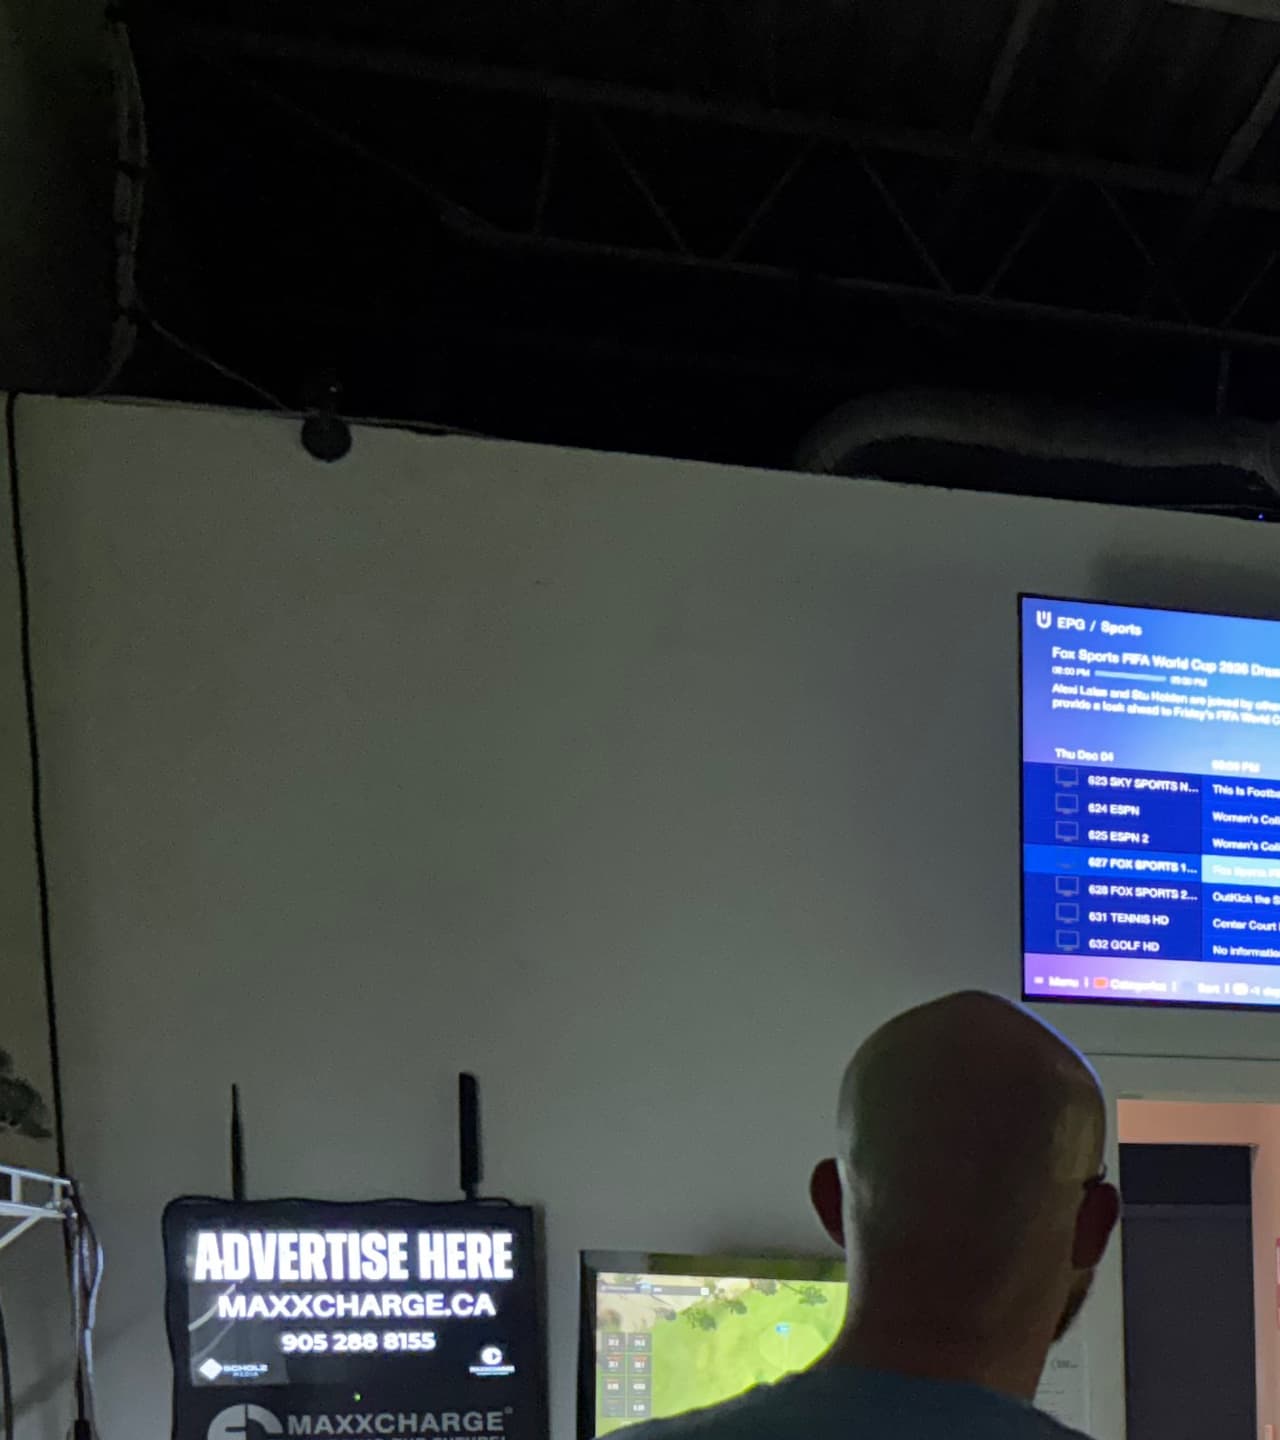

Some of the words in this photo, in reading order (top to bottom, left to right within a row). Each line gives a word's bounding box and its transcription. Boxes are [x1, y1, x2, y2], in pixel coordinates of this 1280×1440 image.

[1057, 616, 1086, 631] EPG
[1101, 620, 1143, 636] Sports
[1052, 646, 1076, 660] Fox
[1078, 649, 1119, 665] Sports
[1122, 653, 1150, 667] FIFA
[1152, 655, 1189, 670] World
[1191, 659, 1218, 673] Cup
[1054, 748, 1076, 760] Thu
[1077, 749, 1099, 762] Dec
[1088, 775, 1108, 787] 623
[1109, 776, 1132, 789] SKY
[1134, 778, 1178, 791] SPORTS
[1212, 783, 1234, 796] This
[1088, 803, 1108, 814] 624
[1109, 803, 1140, 817] ESPN
[1212, 811, 1259, 825] Women's
[1088, 830, 1108, 841] 625
[1109, 830, 1140, 844] ESPN
[1141, 834, 1150, 844] 2
[1212, 838, 1259, 851] Women's
[1109, 858, 1134, 870] FOX
[1134, 859, 1179, 873] SPORTS
[1109, 885, 1134, 897] FOX
[1134, 886, 1179, 900] SPORTS
[1212, 891, 1252, 904] OutKick
[1253, 894, 1271, 905] the
[1088, 911, 1107, 923] 631
[1110, 912, 1151, 925] TENNIS
[1152, 914, 1170, 926] HD
[1212, 918, 1248, 930] Center
[1248, 919, 1277, 932] Court
[1088, 938, 1108, 950] 632
[1110, 939, 1141, 951] GOLF
[1142, 940, 1160, 952] HD
[1212, 944, 1228, 956] No
[194, 1230, 409, 1281] ADVERTISE
[418, 1230, 514, 1280] HERE
[217, 1293, 497, 1319] MAXXCHARGE.CA
[281, 1333, 328, 1353] 905
[332, 1332, 378, 1352] 288
[383, 1331, 437, 1351] 8155
[288, 1411, 505, 1435] MAXXCHARGE
